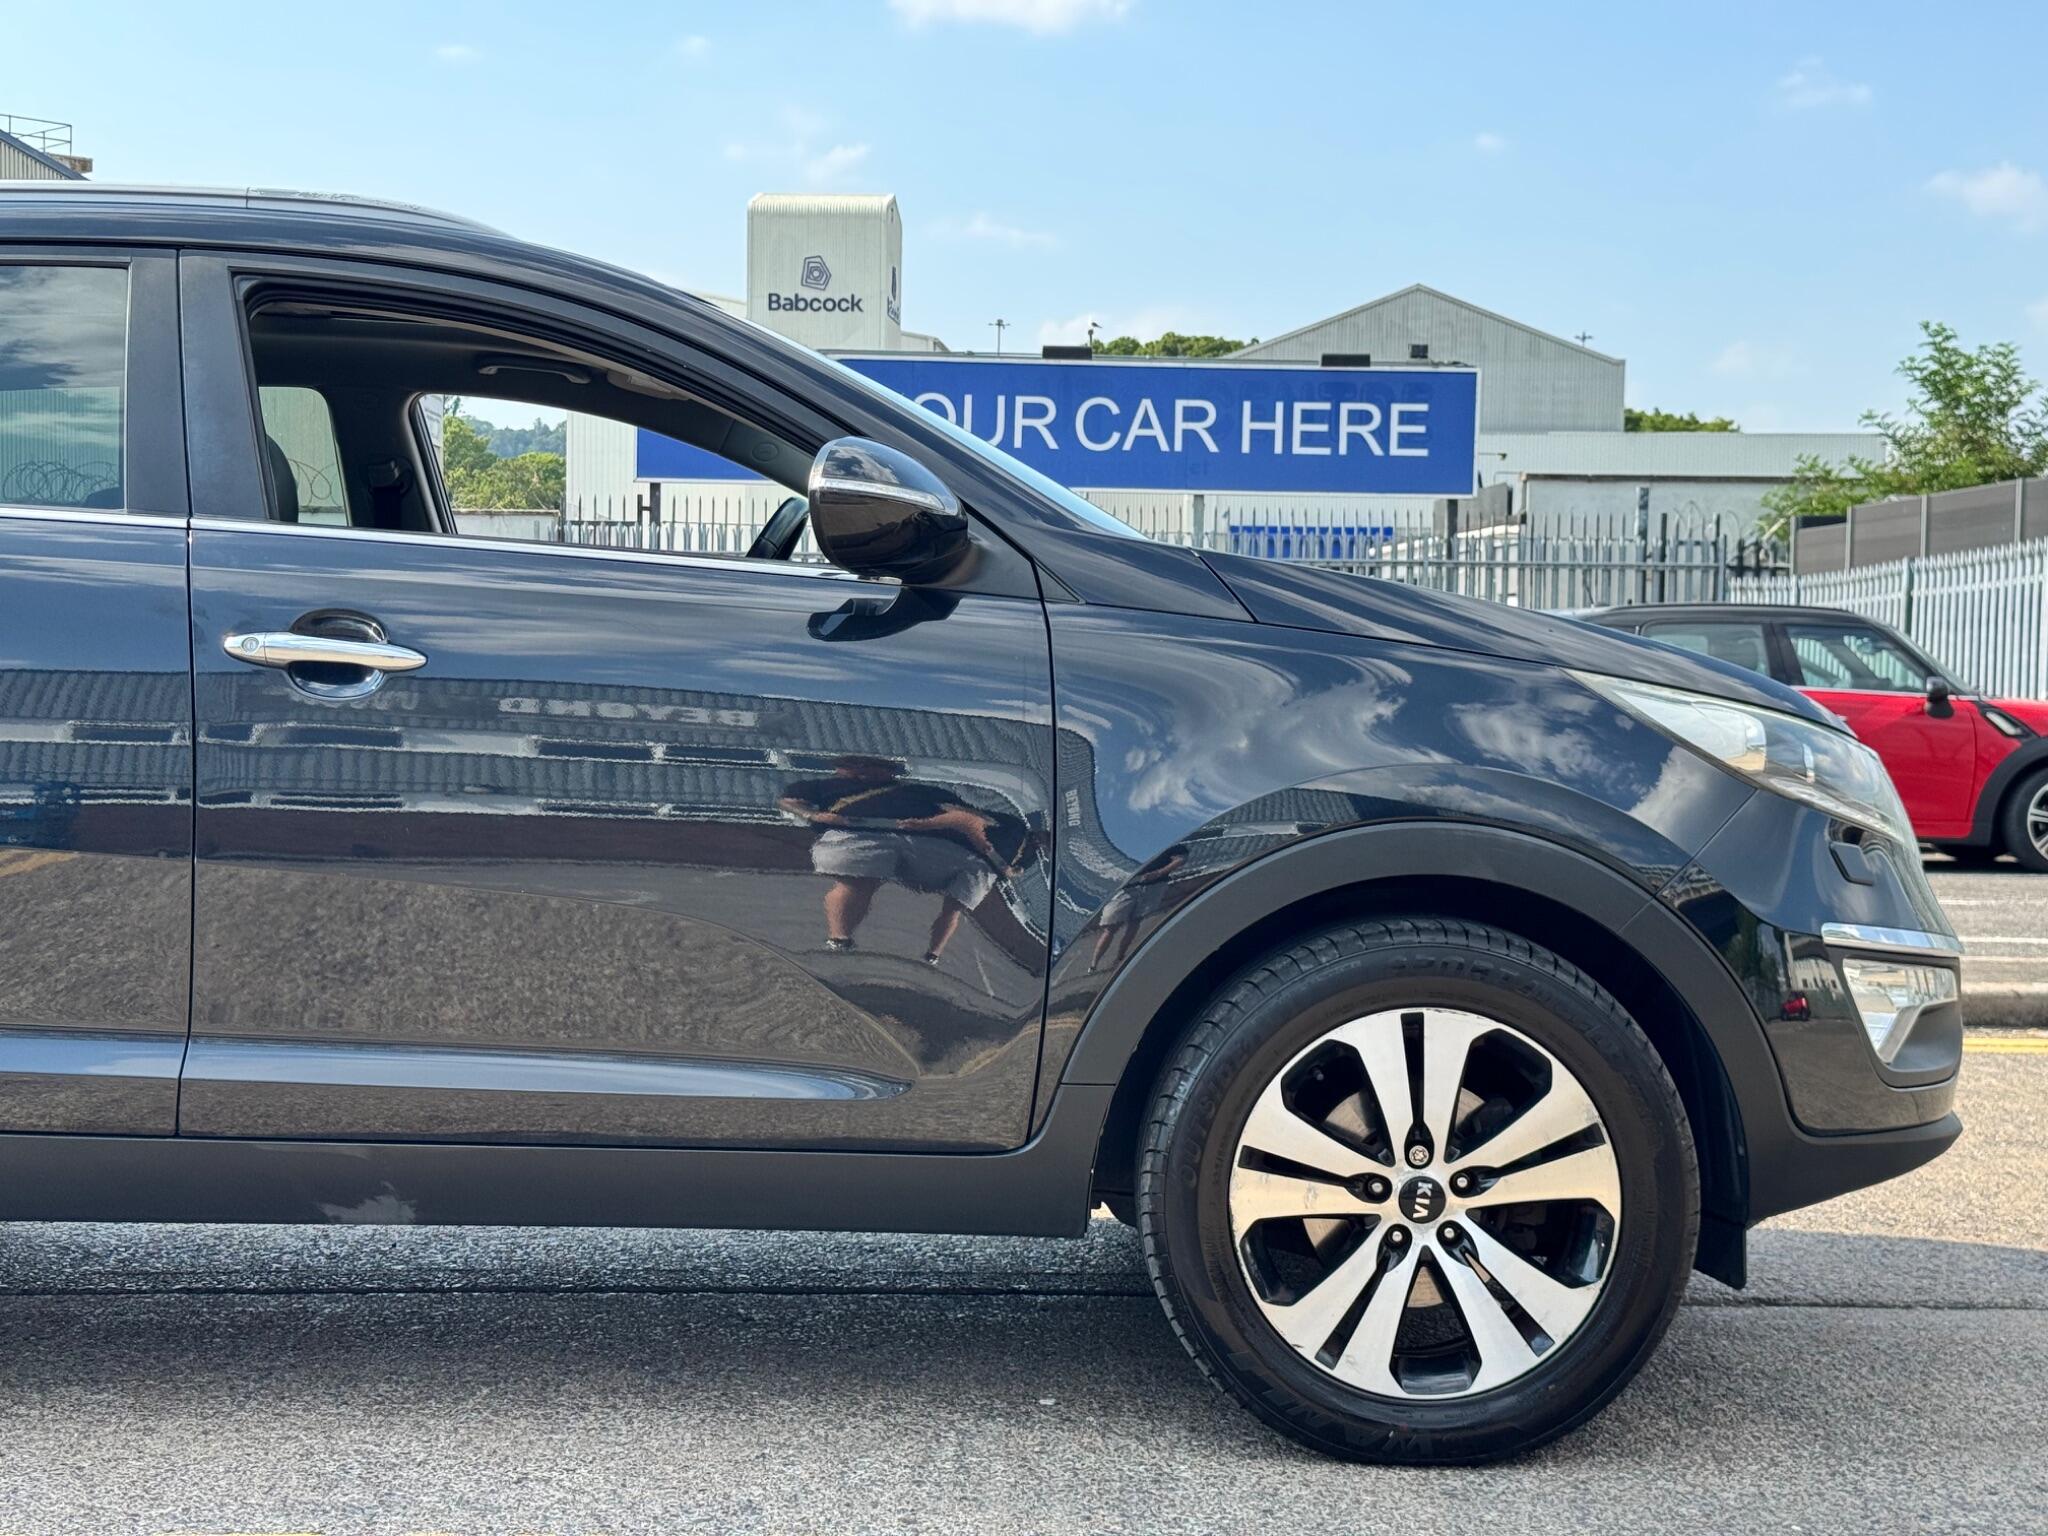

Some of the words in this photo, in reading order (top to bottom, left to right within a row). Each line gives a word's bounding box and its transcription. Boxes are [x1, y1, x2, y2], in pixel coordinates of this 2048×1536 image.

[768, 293, 864, 313] Babcock
[1075, 396, 1219, 453] CAR
[1241, 400, 1429, 457] HERE
[1412, 1182, 1433, 1219] KIA
